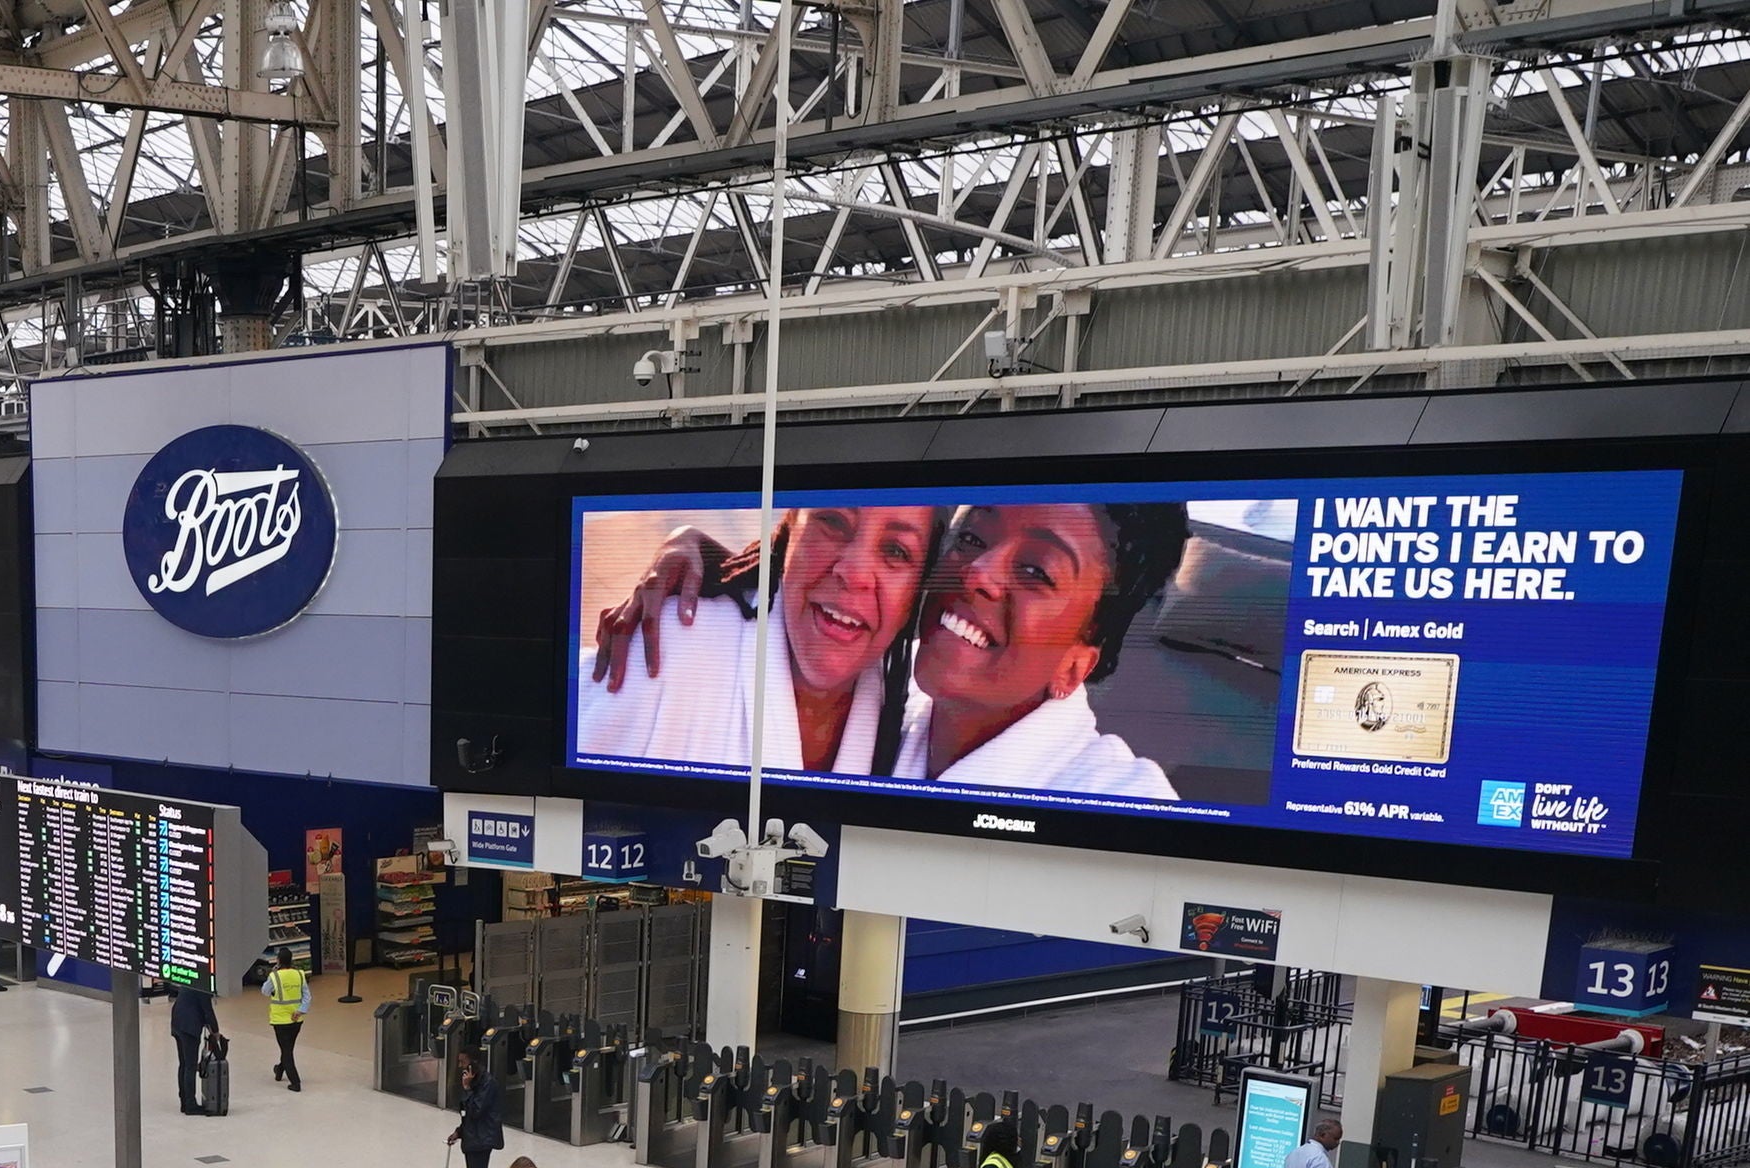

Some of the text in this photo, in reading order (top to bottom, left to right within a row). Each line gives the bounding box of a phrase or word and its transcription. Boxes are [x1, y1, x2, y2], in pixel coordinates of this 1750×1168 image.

[1312, 495, 1518, 528] I WANT THE
[148, 464, 302, 597] Boots
[1309, 530, 1645, 564] POINTS I EARN TO
[1307, 568, 1575, 601] TAKE US HERE.
[1303, 620, 1464, 640] Search Amex Gold
[1333, 667, 1422, 677] AMERICAN EXPRESS
[1291, 758, 1446, 778] Preferred Rewards Gold Credit Card
[18, 780, 98, 804] Next fastest direct train to
[1535, 783, 1572, 795] DON'T
[159, 804, 182, 820] Status
[1286, 801, 1444, 823] Representative 61% APR variable.
[1531, 794, 1608, 821] live life
[973, 813, 1036, 833] JCDecaux
[1531, 819, 1583, 832] WITHOUT
[472, 841, 517, 853] Wide Platform Gate
[587, 844, 645, 870] 12 12
[1232, 915, 1244, 923] Fast
[1246, 917, 1277, 935] WiFi
[1587, 960, 1671, 997] 13 13
[1702, 973, 1732, 982] WARNING
[1591, 1066, 1627, 1094] 13
